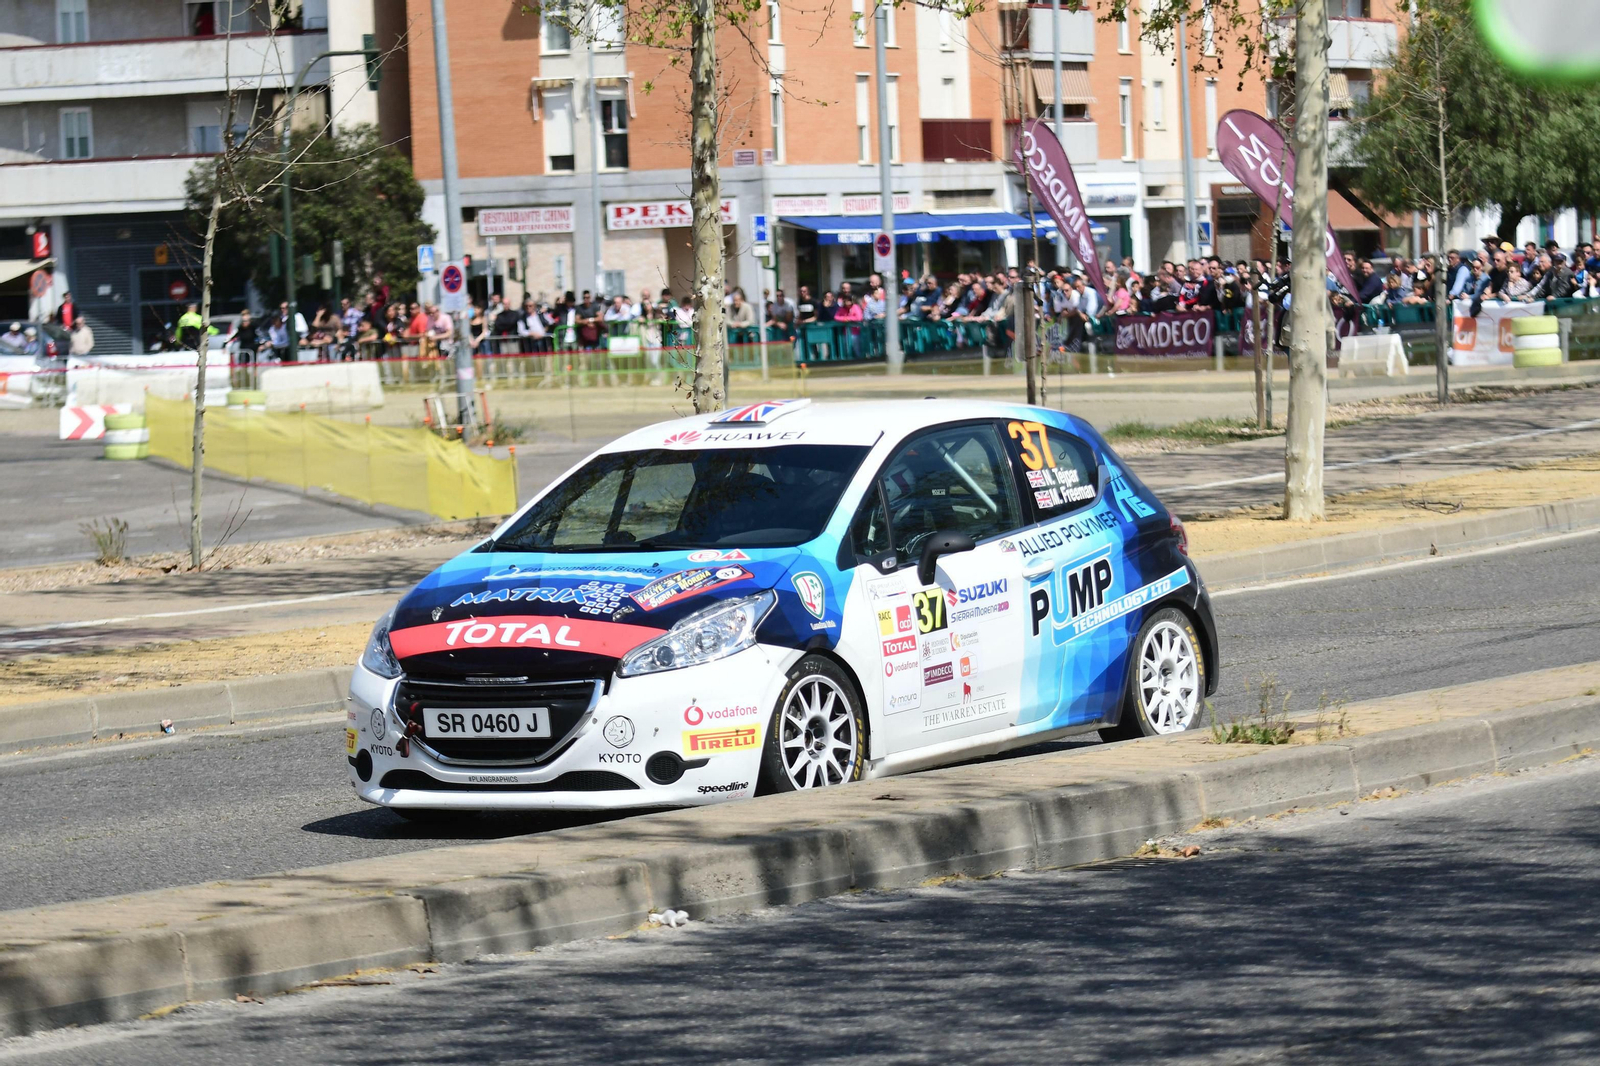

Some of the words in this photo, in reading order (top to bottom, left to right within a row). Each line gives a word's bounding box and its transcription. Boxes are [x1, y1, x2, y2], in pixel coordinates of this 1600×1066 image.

[483, 210, 541, 224] RESTAURANTE
[544, 209, 571, 222] CHINO
[614, 201, 731, 218] PEKN
[1134, 317, 1211, 349] IMDECO
[1454, 324, 1475, 345] lar
[704, 431, 806, 442] HUAWEI
[1008, 421, 1056, 471] 37
[1051, 467, 1080, 487] Tejpar
[1060, 484, 1097, 504] Freeman
[1018, 530, 1064, 558] ALLIED
[1064, 510, 1122, 544] POLYMER
[521, 564, 612, 573] Environmental
[613, 565, 664, 574] Biotech
[450, 587, 594, 607] MATRIX
[648, 588, 678, 608] SIERRA
[679, 570, 712, 591] MORENA
[958, 577, 1008, 604] SUZUKI
[1030, 558, 1113, 637] PUMP
[877, 611, 892, 621] RACC
[913, 588, 945, 634] 37
[1072, 590, 1149, 635] TECHNOLOGY
[1150, 579, 1172, 598] LTD
[446, 620, 580, 647] TOTAL
[884, 641, 916, 655] TOTAL
[893, 661, 919, 672] vodafone
[929, 664, 953, 679] IMDECO
[706, 705, 758, 719] vodafone
[923, 714, 941, 728] THE
[941, 704, 978, 724] WARREN
[978, 697, 1008, 714] ESTATE
[437, 713, 467, 733] SR
[471, 713, 521, 733] 0460
[526, 712, 539, 732] J
[689, 728, 756, 751] PIRELLI
[370, 743, 394, 757] KYOTO
[598, 753, 642, 764] KYOTO
[697, 781, 749, 794] speedline
